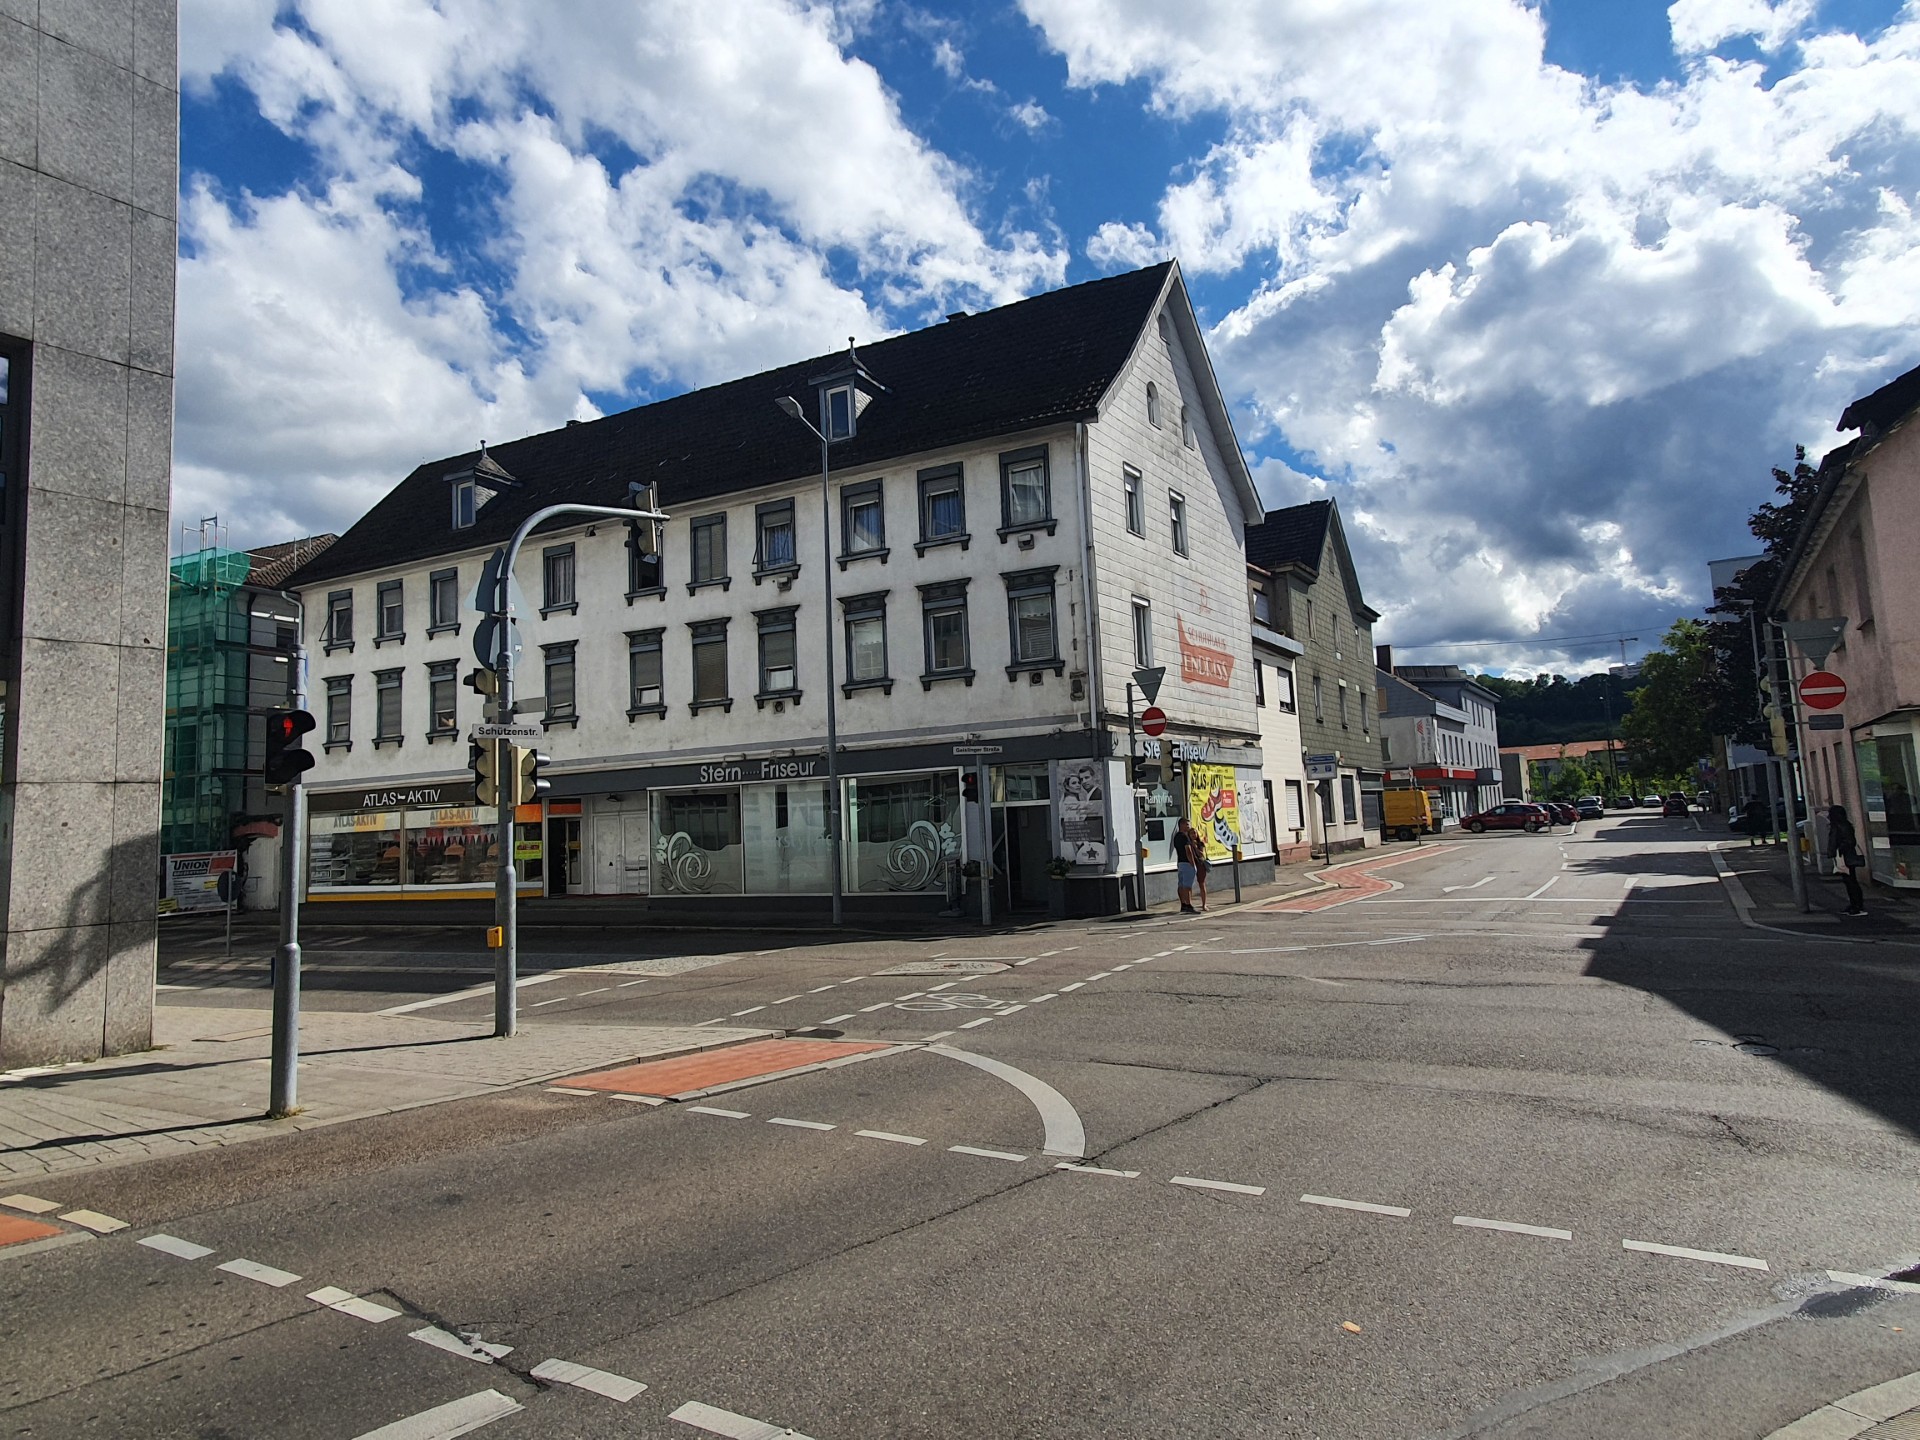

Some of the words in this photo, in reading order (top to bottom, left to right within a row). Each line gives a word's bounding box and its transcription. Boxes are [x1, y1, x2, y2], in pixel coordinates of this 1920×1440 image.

[478, 726, 538, 736] Schützenstr.
[700, 765, 742, 783] Stern
[760, 761, 816, 779] Friseur
[430, 807, 479, 821] ATLAS-AKTIV
[171, 859, 210, 871] UNION
